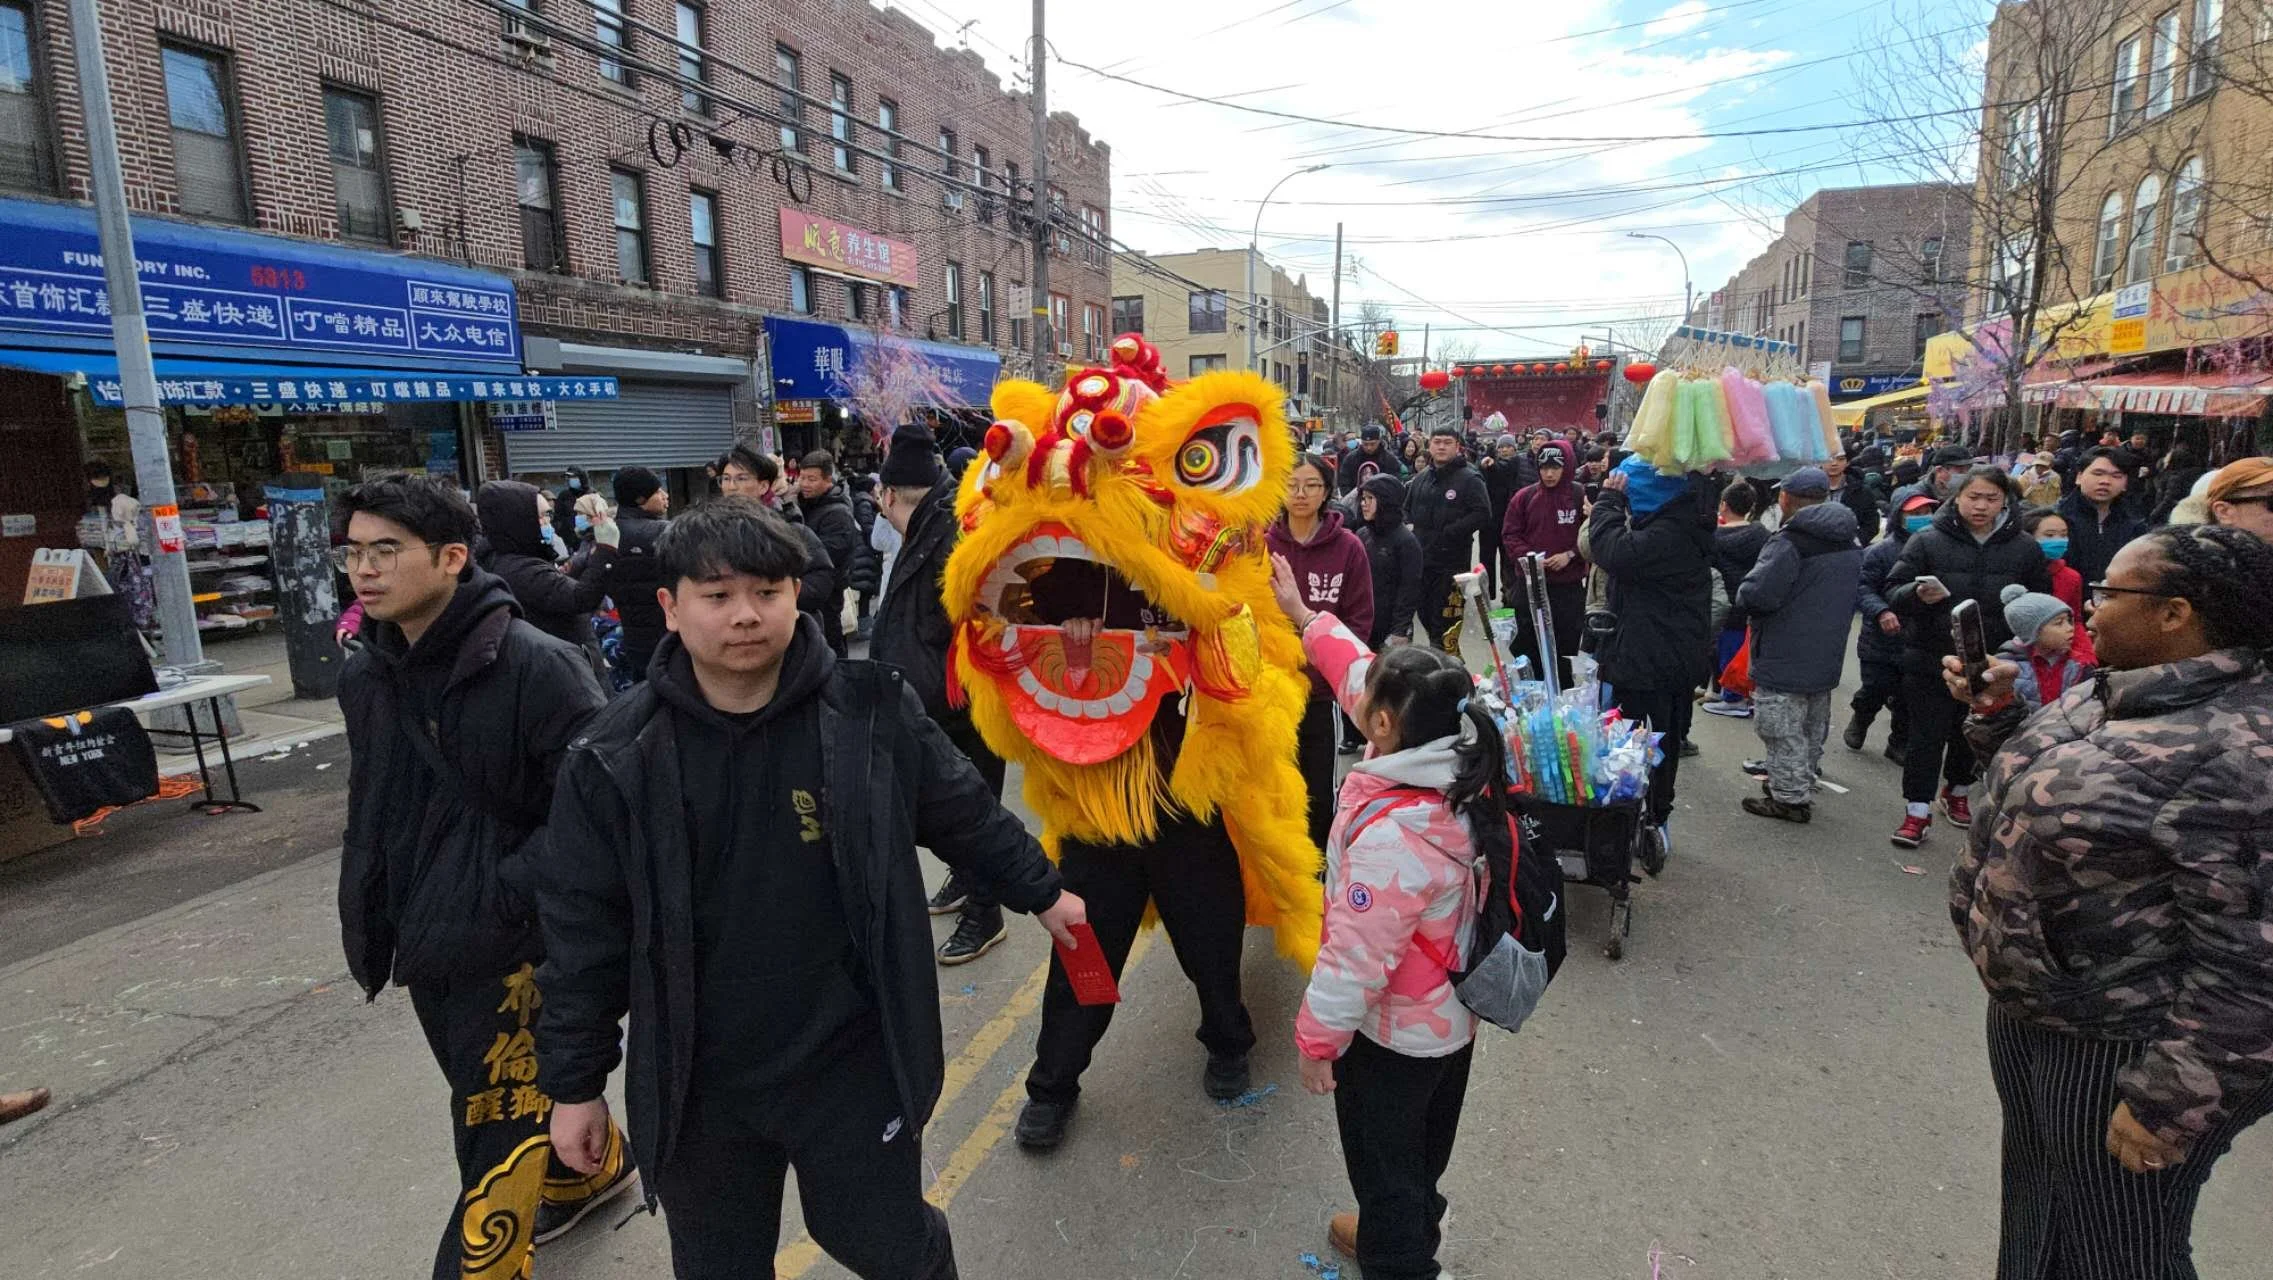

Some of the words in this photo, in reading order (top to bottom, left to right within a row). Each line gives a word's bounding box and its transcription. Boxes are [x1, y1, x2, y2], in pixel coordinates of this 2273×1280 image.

[175, 264, 211, 280] INC.
[143, 296, 278, 330] 三盛快递
[420, 321, 507, 347] 大众电信
[251, 382, 349, 399] 三盛快递
[558, 381, 617, 397] 大众手机
[60, 753, 79, 766] NEW
[81, 748, 104, 761] YORK
